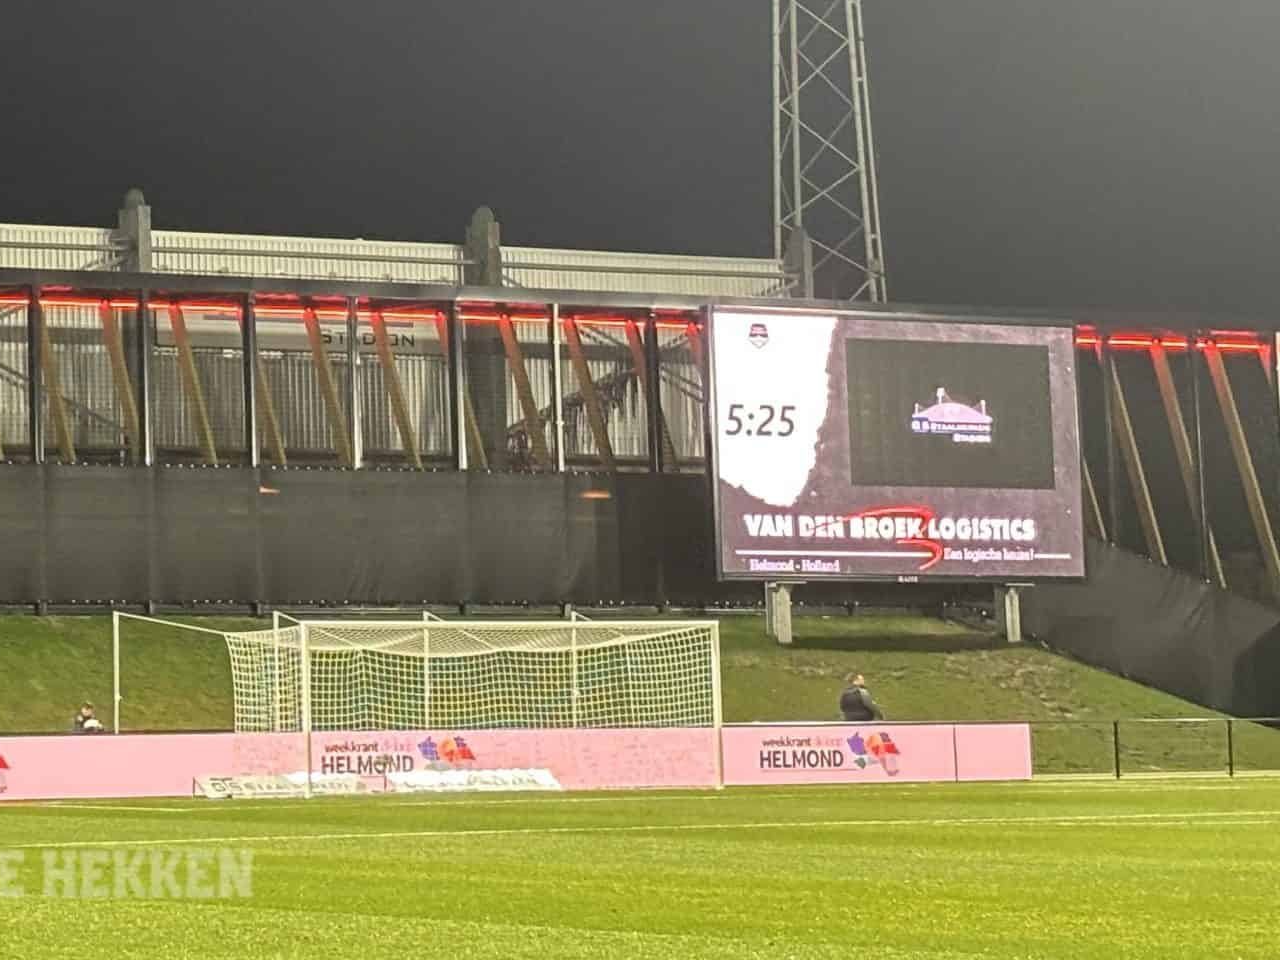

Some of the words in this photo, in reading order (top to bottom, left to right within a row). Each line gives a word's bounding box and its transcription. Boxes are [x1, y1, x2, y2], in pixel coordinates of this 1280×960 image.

[320, 331, 414, 347] STDON
[725, 404, 796, 437] 5:25
[743, 514, 793, 537] VAN
[798, 515, 845, 538] DEN
[849, 516, 923, 539] BROEK
[928, 518, 1036, 540] LOGISTICS
[321, 754, 414, 775] HELMOND
[760, 749, 844, 769] HELMOND
